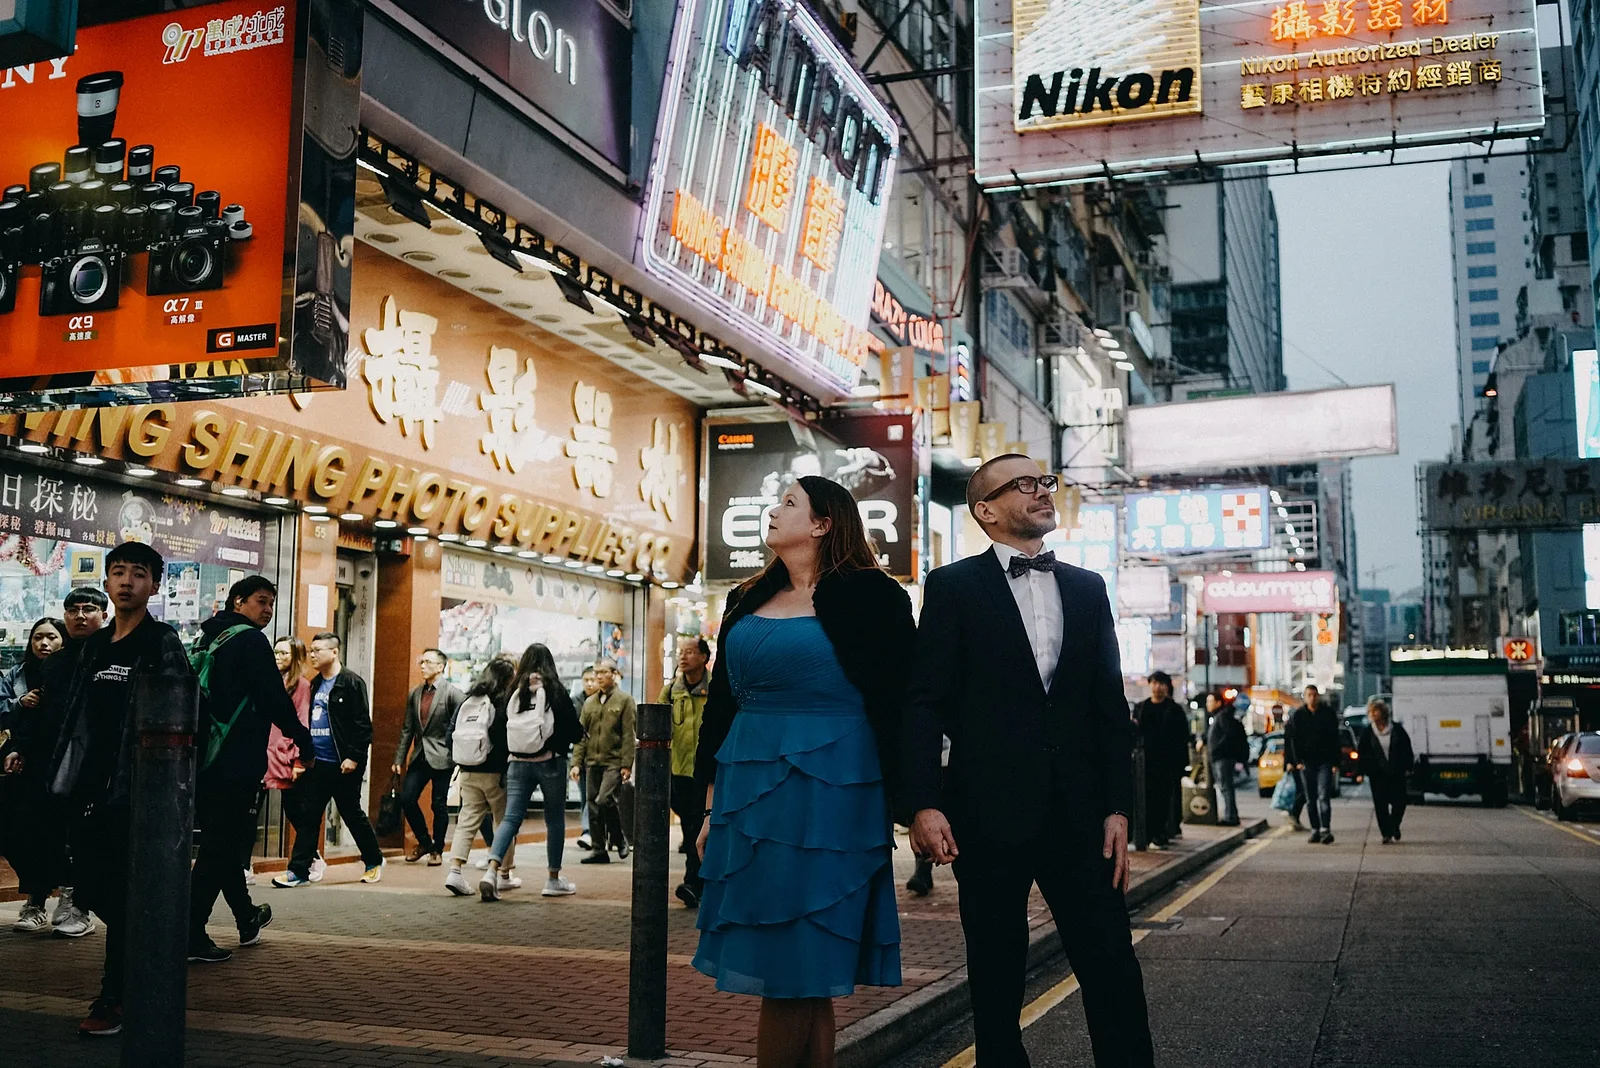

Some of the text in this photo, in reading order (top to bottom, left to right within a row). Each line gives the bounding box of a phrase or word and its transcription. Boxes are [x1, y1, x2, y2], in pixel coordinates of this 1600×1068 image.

[1270, 0, 1450, 42] 攝影器材
[1240, 32, 1499, 77] Nikon Authorized Dealer
[1018, 66, 1194, 121] Nikon
[187, 227, 204, 235] SONY
[670, 187, 725, 264] WING
[218, 333, 268, 347] G MASTER
[718, 434, 754, 444] Canon
[180, 409, 351, 498] SHING
[350, 455, 494, 533] PHOTO
[493, 492, 638, 568] SUPPLIES
[1461, 501, 1562, 522] VIRGINIA
